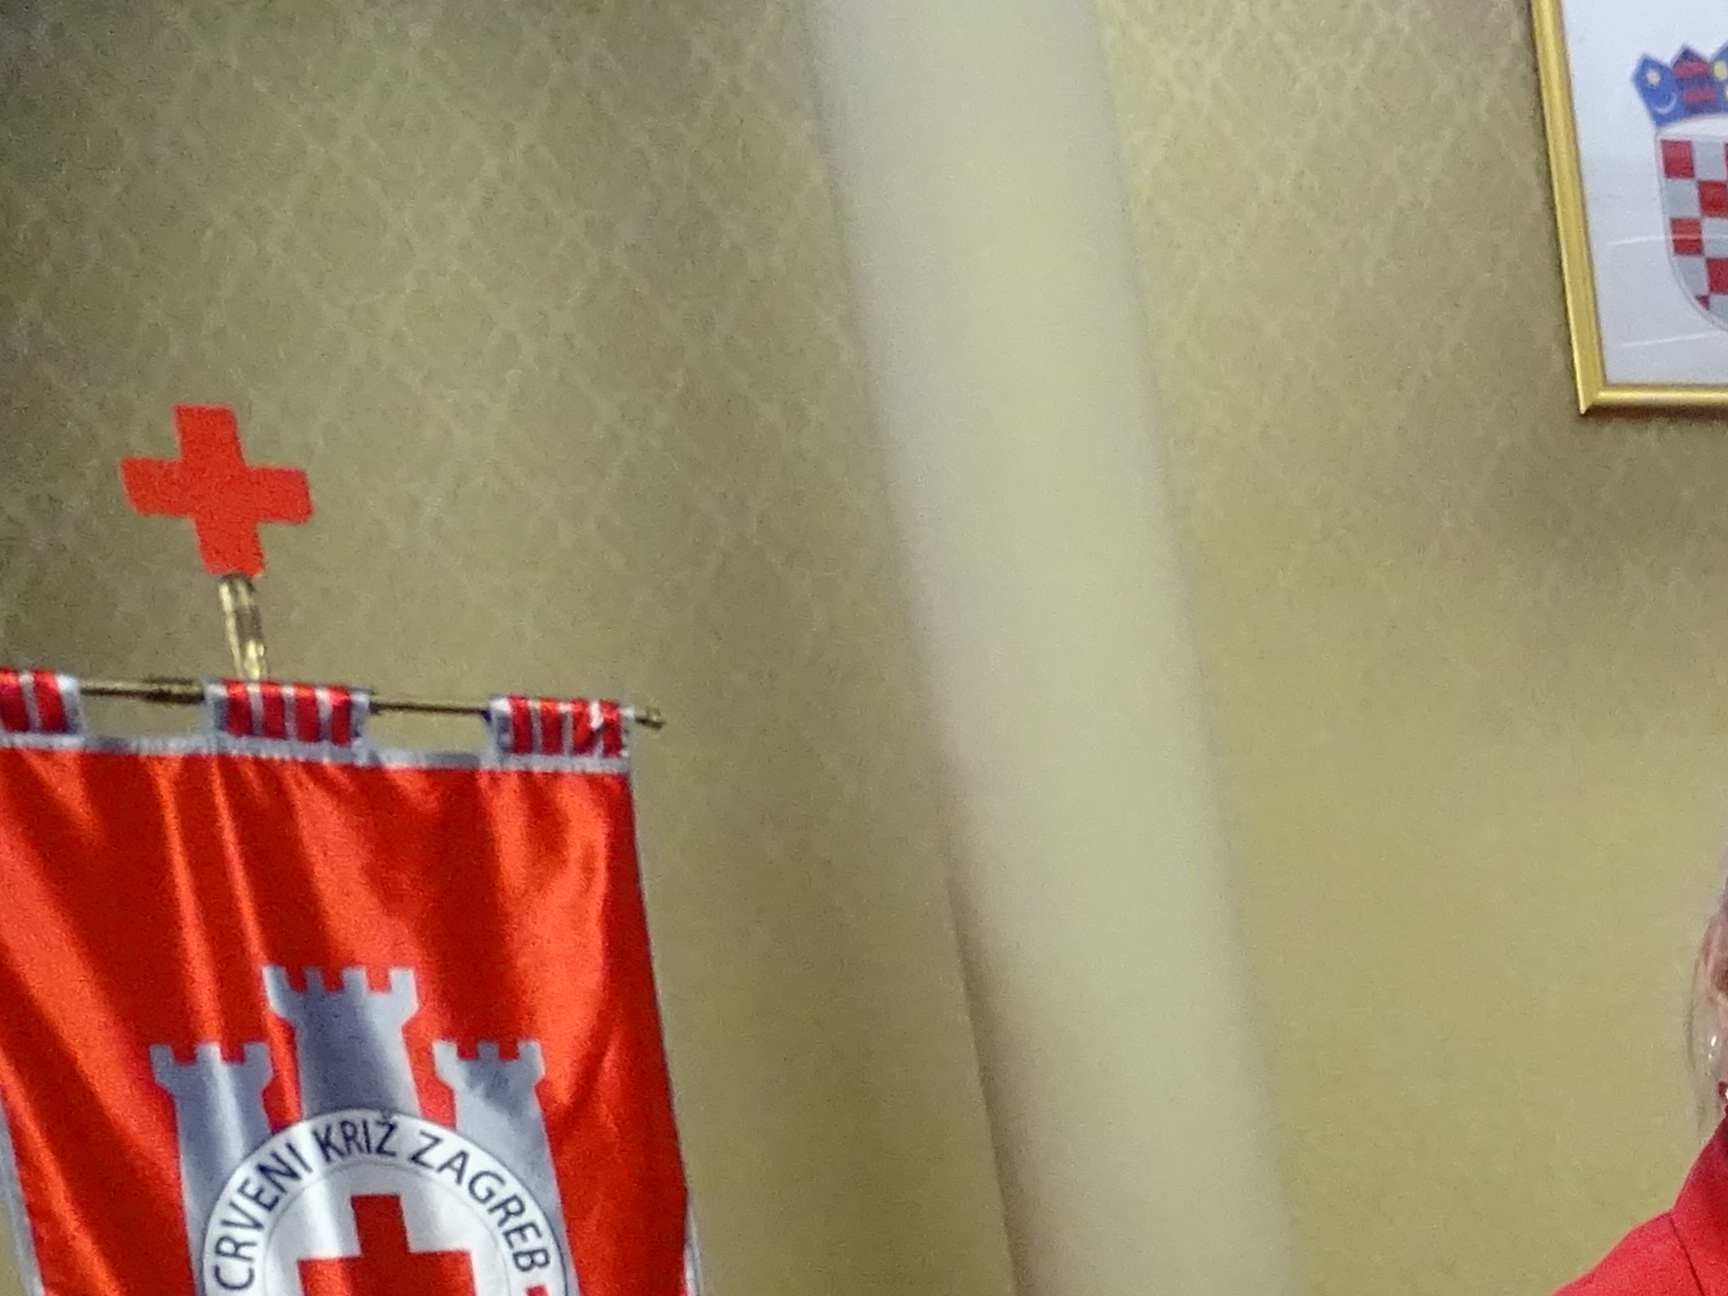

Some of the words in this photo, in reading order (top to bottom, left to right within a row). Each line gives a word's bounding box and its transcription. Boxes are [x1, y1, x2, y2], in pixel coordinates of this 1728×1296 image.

[214, 1142, 314, 1292] CRVENI
[310, 1110, 398, 1163] KRIŽ
[408, 1131, 551, 1273] ZAGREB
